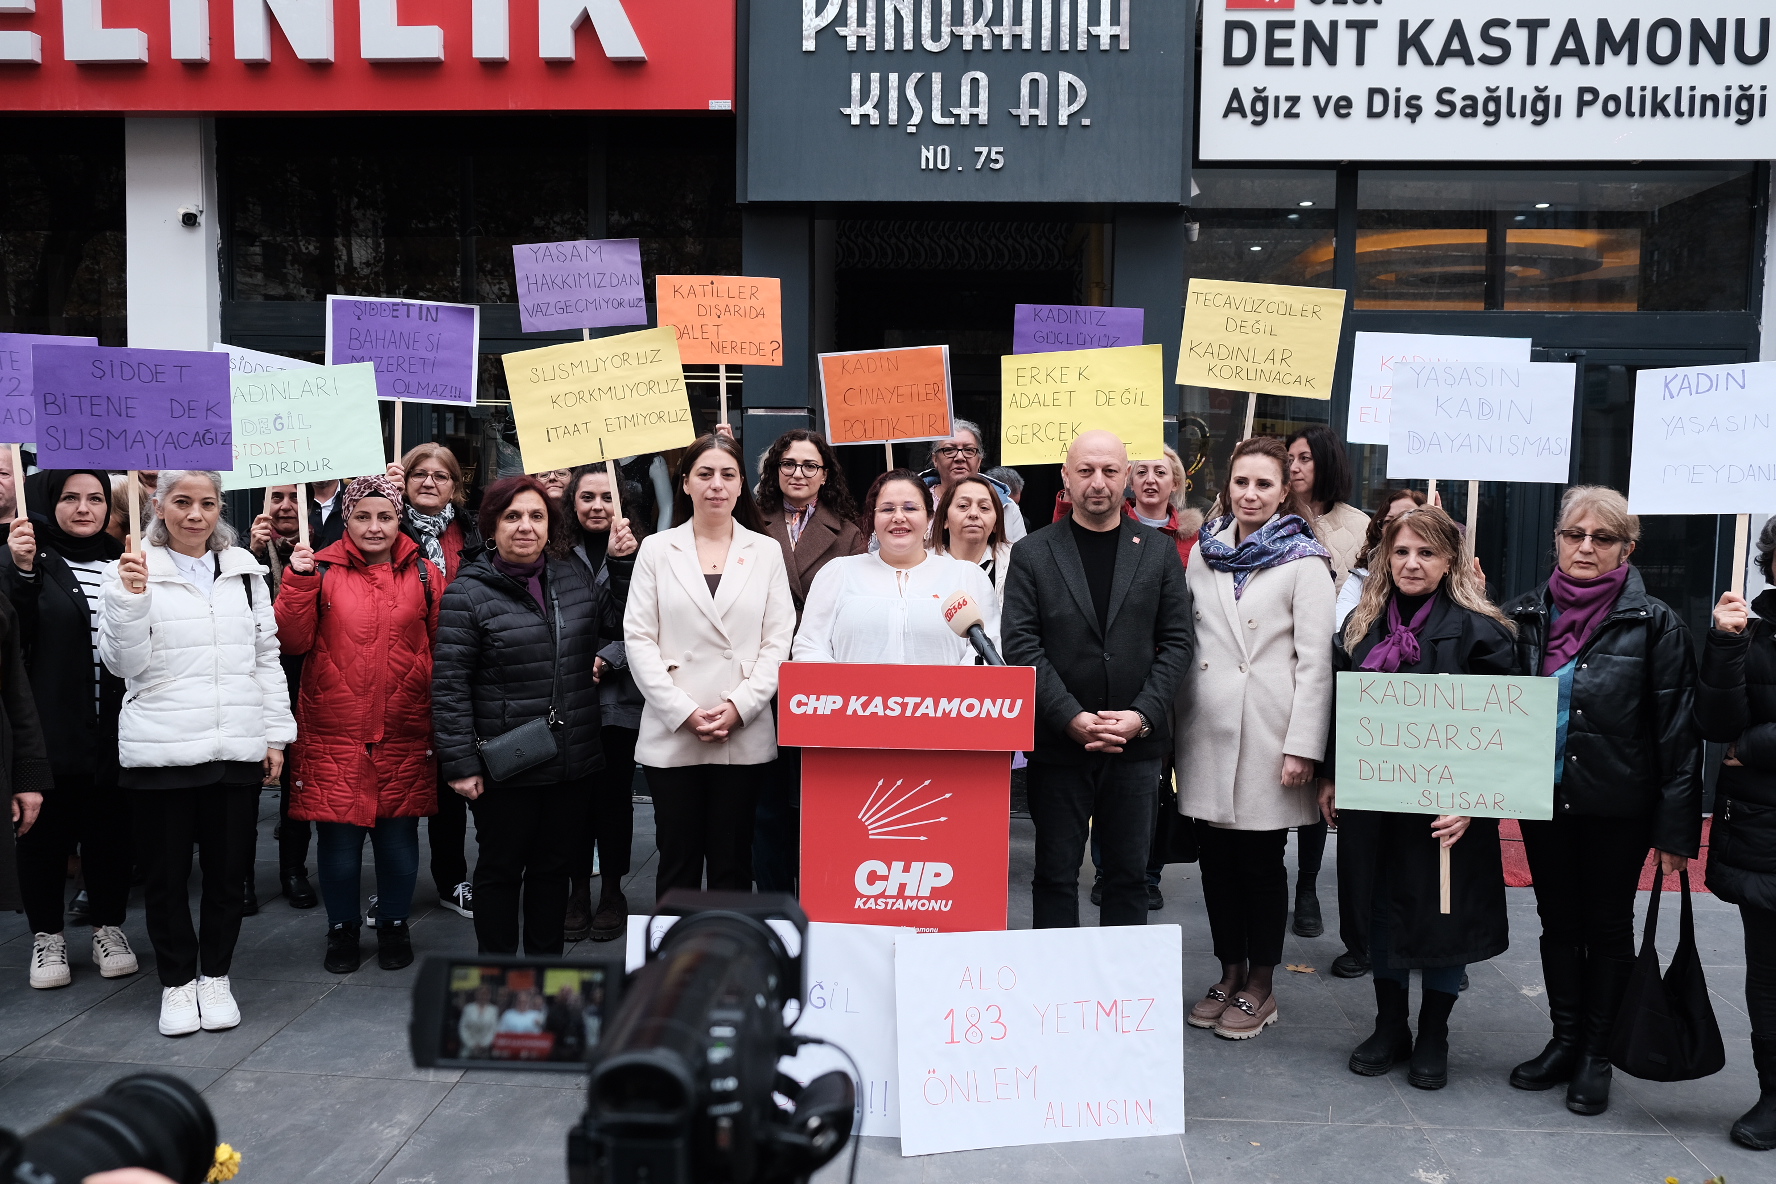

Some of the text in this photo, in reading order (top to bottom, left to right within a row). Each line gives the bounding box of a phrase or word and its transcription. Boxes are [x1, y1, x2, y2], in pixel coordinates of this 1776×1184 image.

[1222, 17, 1772, 67] DENT KASTAMONU
[839, 70, 1091, 133] KIŞLA AP.
[1222, 85, 1769, 126] Ağız ve Diş Sağlığı Polikliniği
[974, 145, 1005, 170] 75
[529, 243, 603, 264] YAŞAM
[525, 272, 641, 294] HAKKIMIZDAN
[673, 280, 759, 301] KATİLLER
[523, 296, 645, 318] VAZGEÇMİYORUZ
[697, 304, 765, 319] DIŞARIDA
[1033, 307, 1107, 327] KADINIZ
[1192, 291, 1322, 321] TECAVÜZCÜLER
[1033, 330, 1121, 347] GÜÇLÜYÜZ
[1225, 316, 1278, 336] DEĞİL
[348, 327, 442, 353] BAHANESİ
[710, 340, 781, 362] NEREDE?
[529, 349, 663, 383] SUSMUYORUZ
[842, 356, 899, 375] KADIN
[1188, 340, 1293, 368] KADINLAR
[91, 360, 193, 383] ŞİDDET
[1016, 365, 1090, 387] ERKEK
[1207, 363, 1316, 389] KORUNACAK
[1410, 366, 1520, 388] YAŞASIN
[1663, 369, 1746, 400] KADIN
[233, 377, 339, 404] ADINLARI
[550, 378, 683, 410] KORKMUYORUZ
[843, 380, 944, 406] CİNAYETLERİ
[1009, 388, 1150, 409] ADALET DEĞİL
[43, 392, 223, 420] BİTENE DEK
[1435, 395, 1533, 424] KADIN
[241, 411, 312, 436] DEĞİL
[604, 409, 690, 433] ETMİYORUZ
[1005, 421, 1082, 445] GERÇEK
[1661, 413, 1769, 440] YAŞASIN
[45, 425, 233, 452] SUSMAYACAĞIZ
[1408, 430, 1568, 457] DAYANIŞMASI
[249, 458, 333, 478] DURDUR
[789, 694, 1023, 719] CHP KASTAMONU
[1358, 678, 1529, 716] KADINLAR
[1356, 717, 1504, 751] SUSARSA
[1358, 759, 1455, 785] DÜNYA
[854, 859, 954, 897] CHP
[854, 897, 954, 912] KASTAMONU
[959, 965, 1017, 991] ALO
[943, 998, 1155, 1045] 183 YETMEZ
[923, 1064, 1038, 1106] ÖNLEM
[1044, 1098, 1154, 1129] ALINSIN
